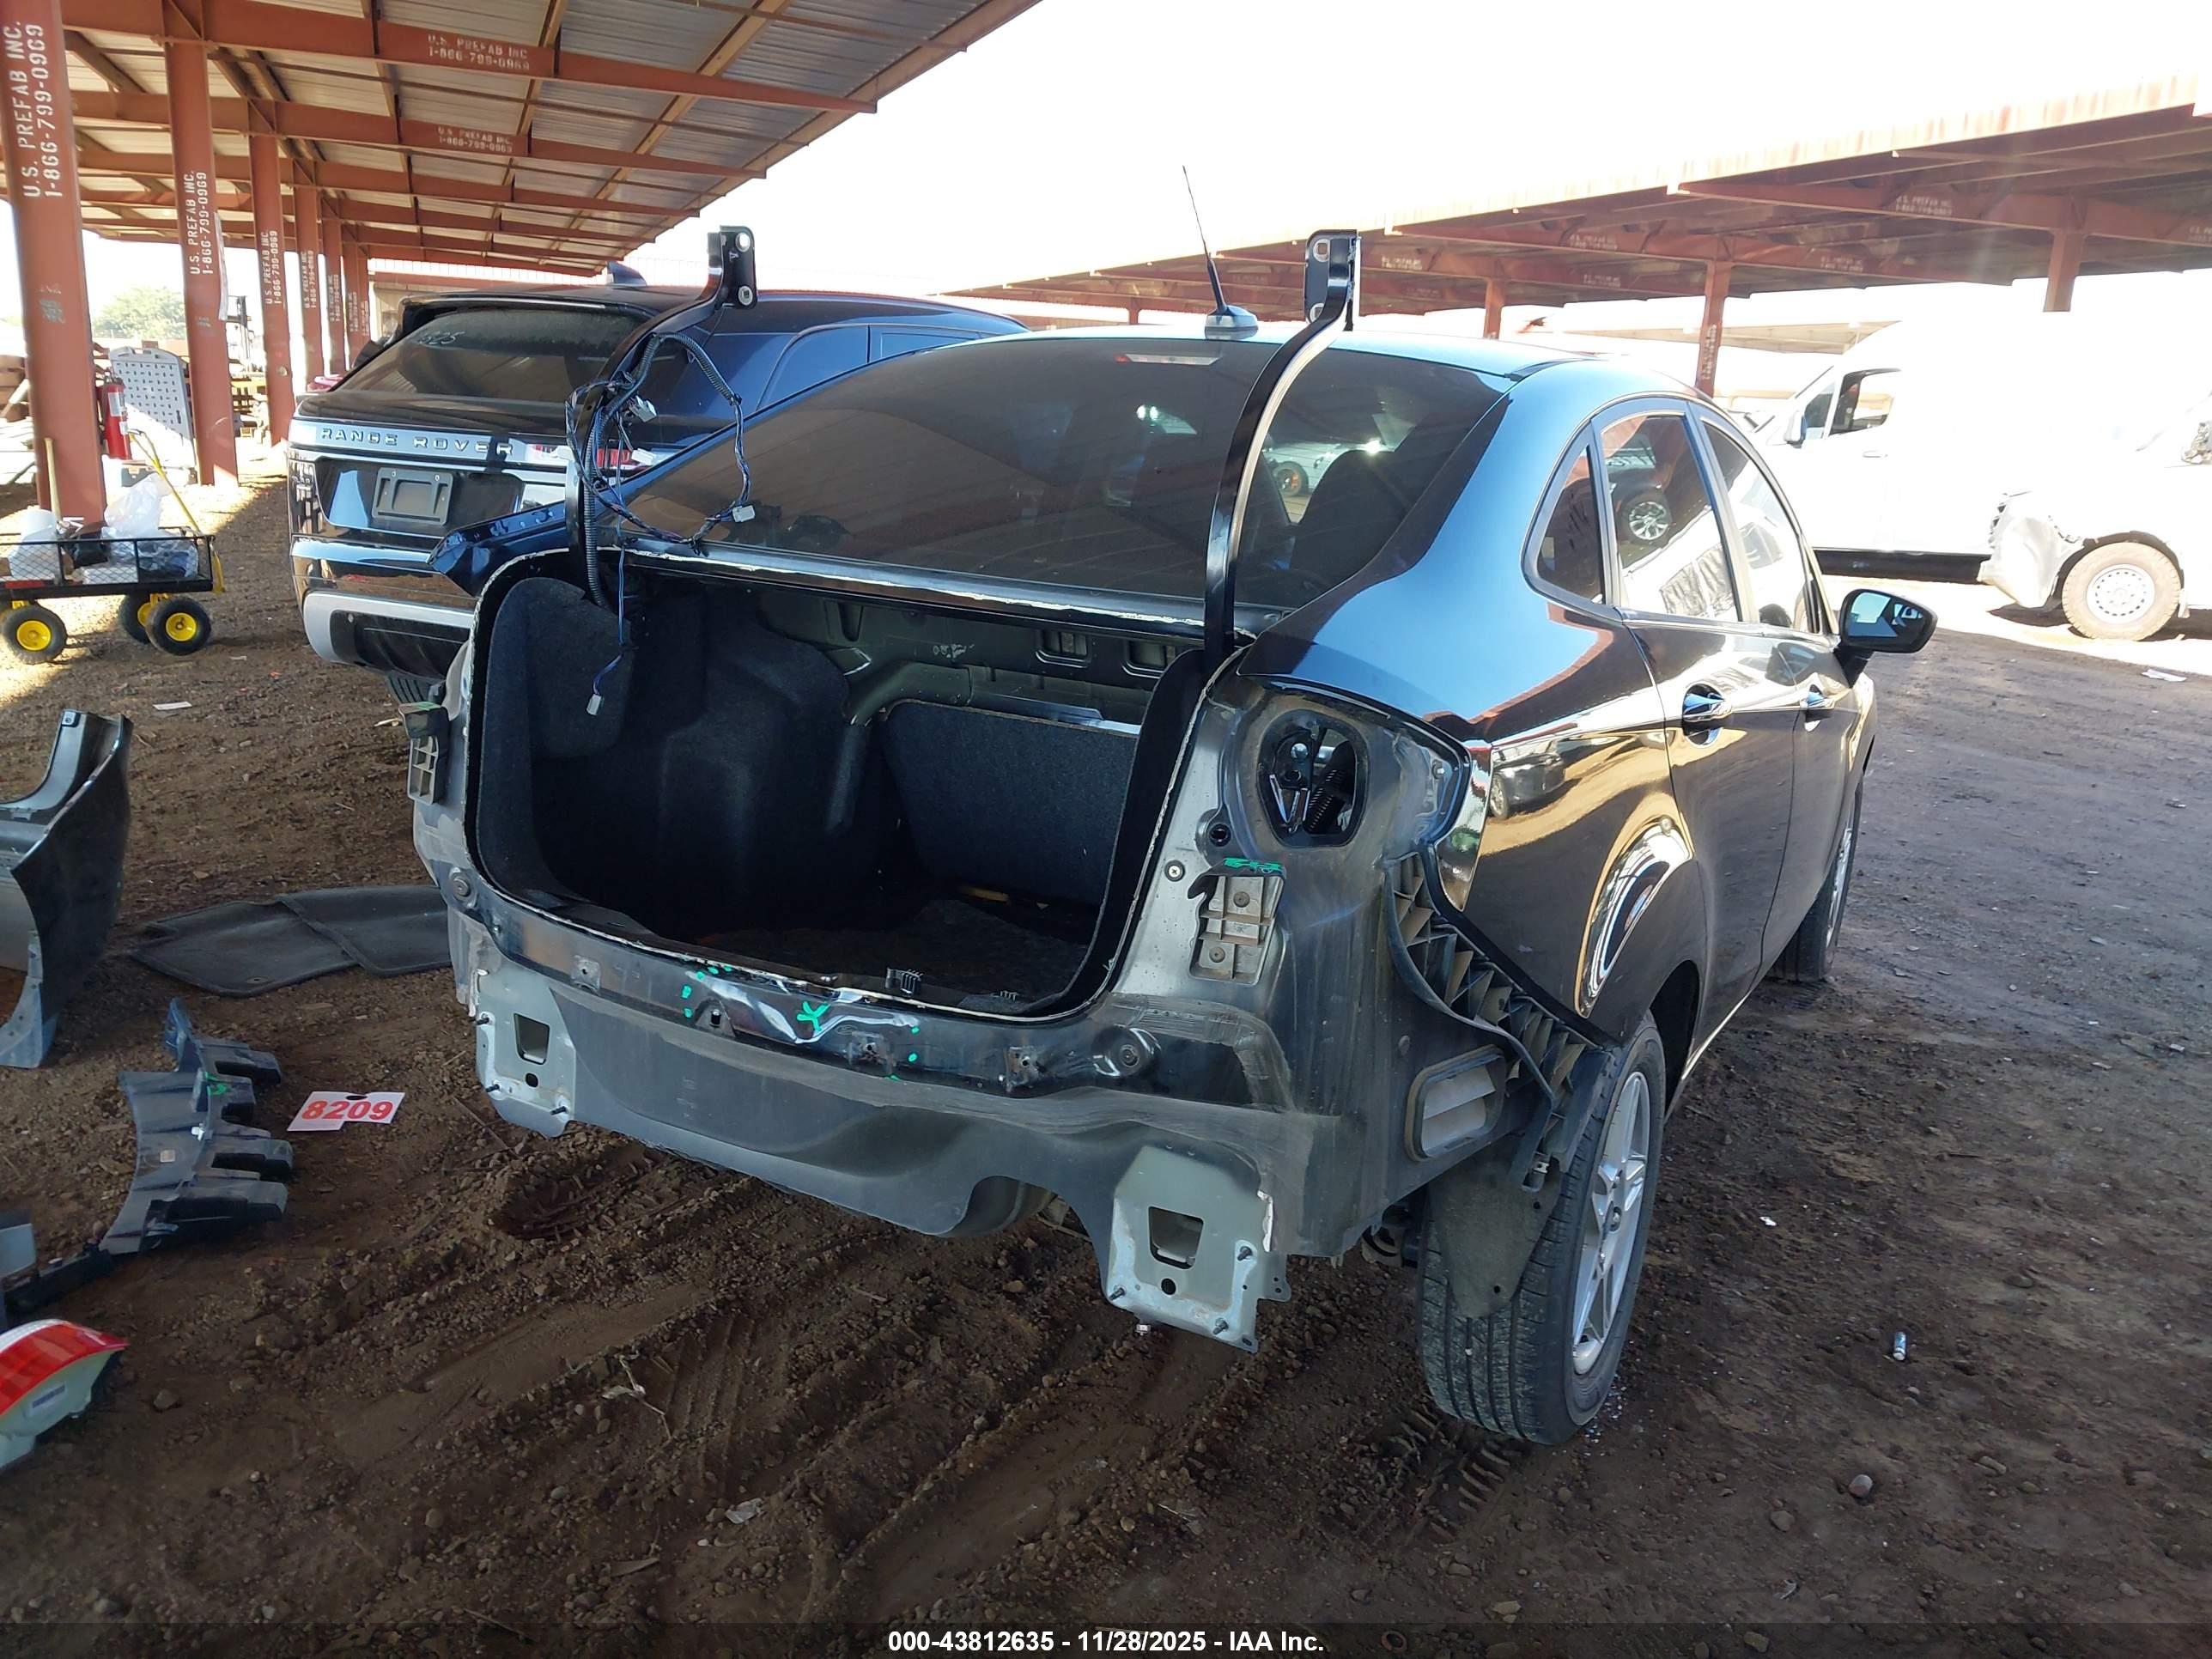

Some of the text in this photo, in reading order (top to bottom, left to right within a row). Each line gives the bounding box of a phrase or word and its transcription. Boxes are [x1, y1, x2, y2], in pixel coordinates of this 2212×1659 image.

[3, 21, 42, 198] U.S. PREFAB INC.
[25, 24, 63, 198] 1-866-799-0969
[185, 199, 198, 246] PREFAB
[196, 172, 214, 275] 1-866-799-0969
[189, 252, 201, 275] U.S.
[261, 249, 271, 284] PREFAB
[322, 427, 514, 456] RANGE ROVER
[301, 1100, 393, 1121] 8209
